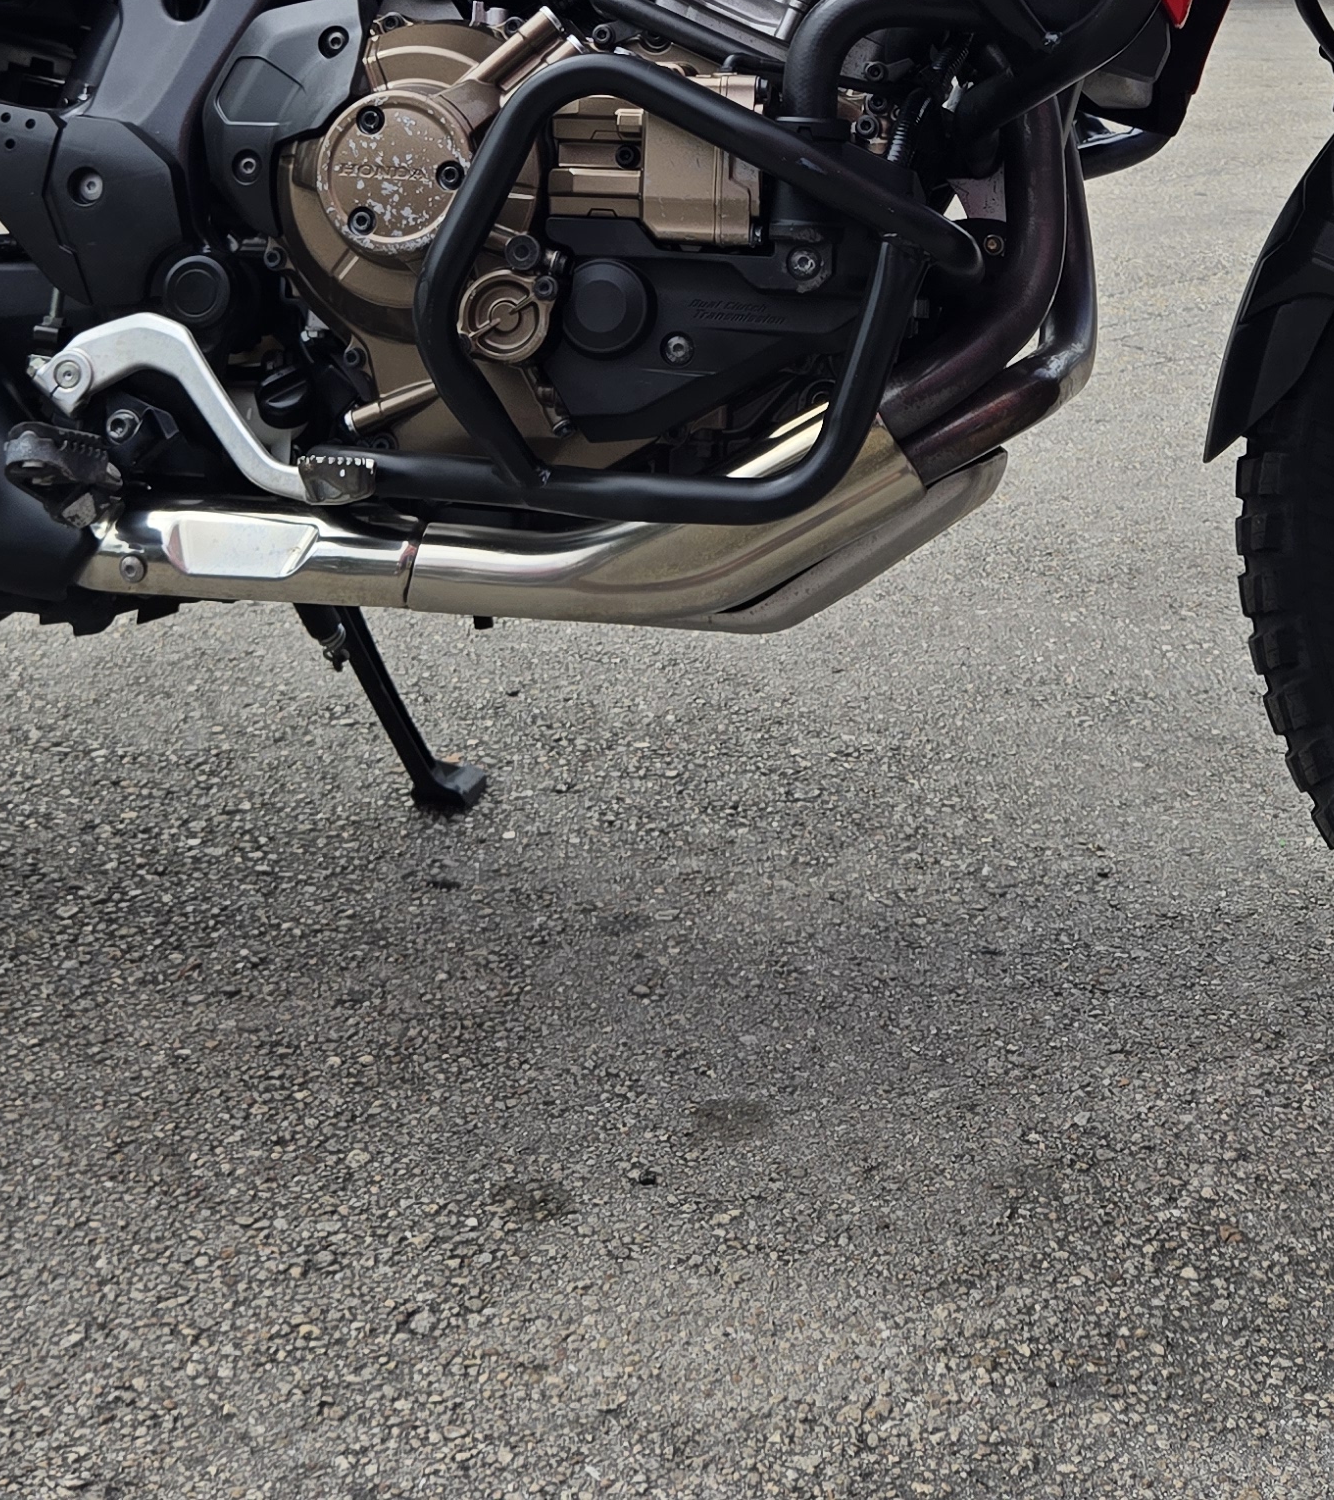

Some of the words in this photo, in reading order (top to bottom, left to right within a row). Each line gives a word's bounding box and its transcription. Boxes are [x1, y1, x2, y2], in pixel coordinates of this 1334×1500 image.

[337, 162, 430, 184] HONDA
[723, 300, 767, 313] Clutch
[693, 308, 787, 325] Transmission
